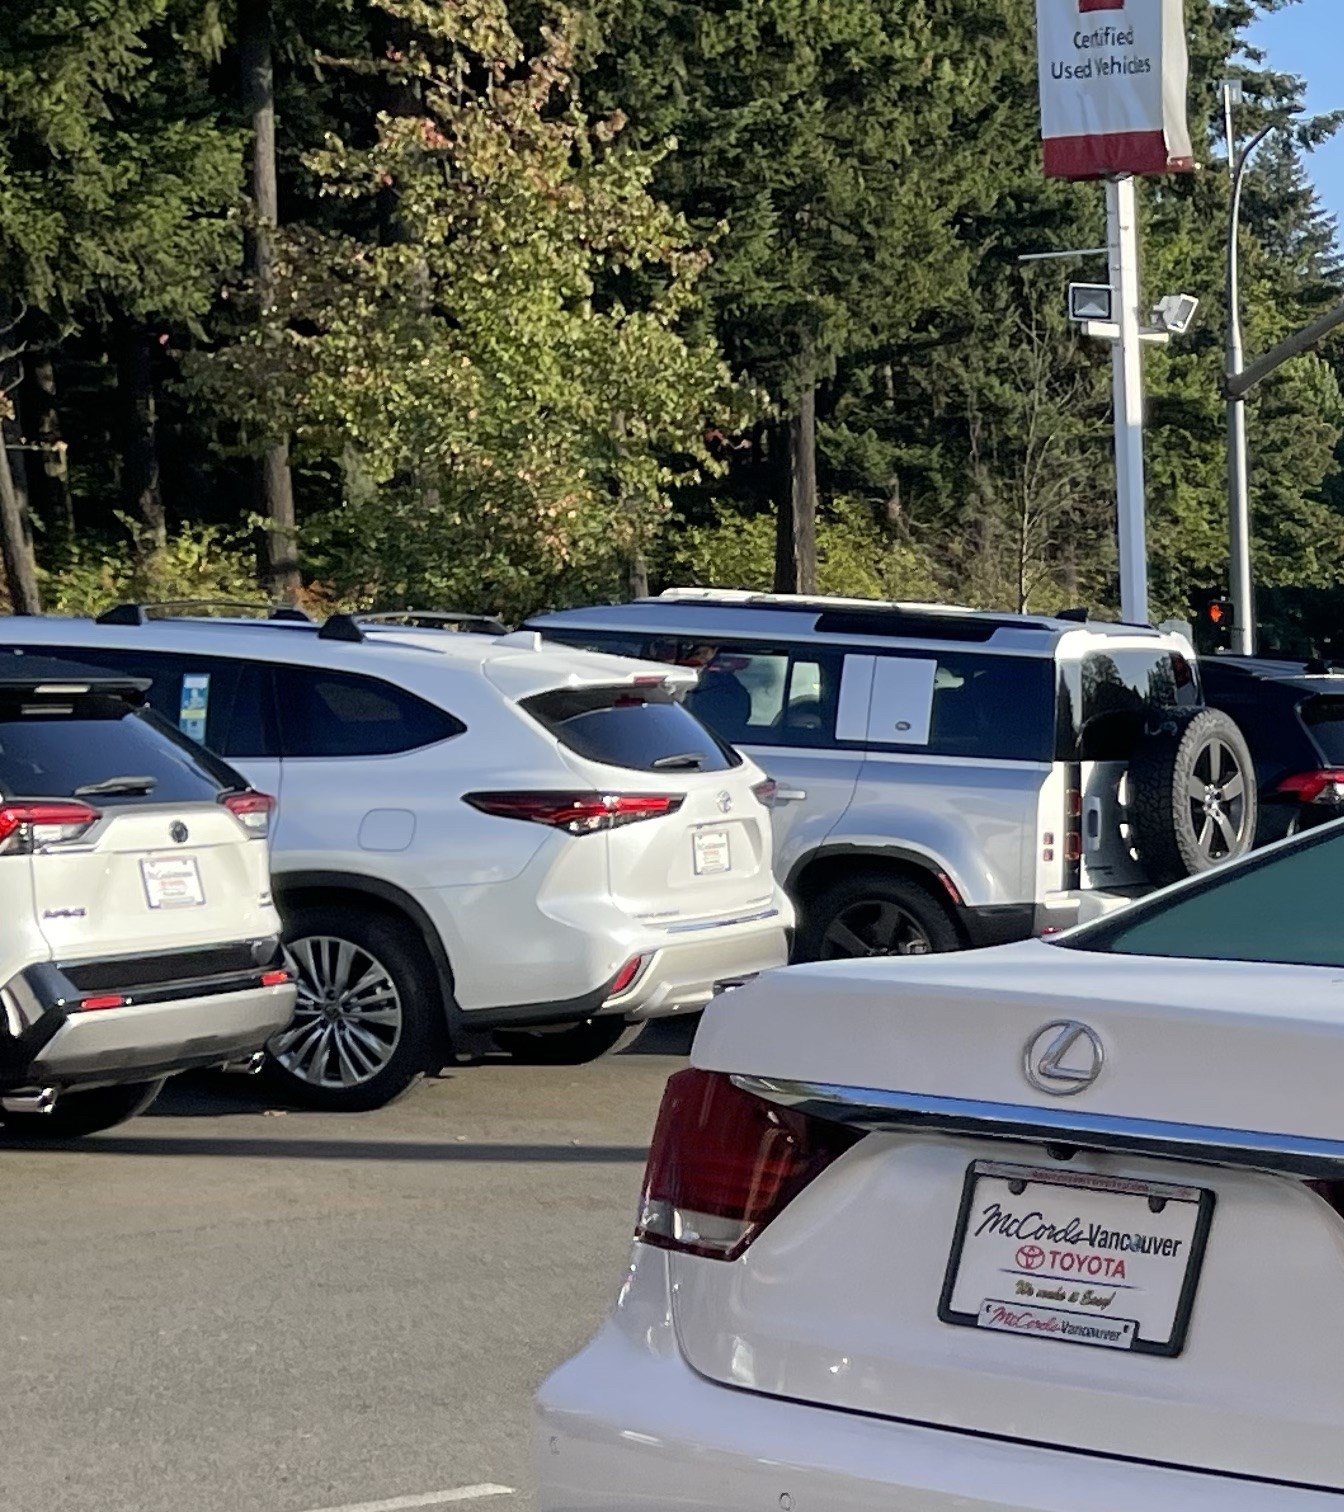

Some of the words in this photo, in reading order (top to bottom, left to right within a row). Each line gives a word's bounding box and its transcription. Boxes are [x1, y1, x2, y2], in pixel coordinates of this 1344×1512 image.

[1074, 25, 1134, 49] Certified
[1051, 59, 1092, 79] Used
[1096, 55, 1151, 76] Vehicles
[1089, 1223, 1182, 1257] Vancouver
[1050, 1251, 1126, 1279] TOYOTA
